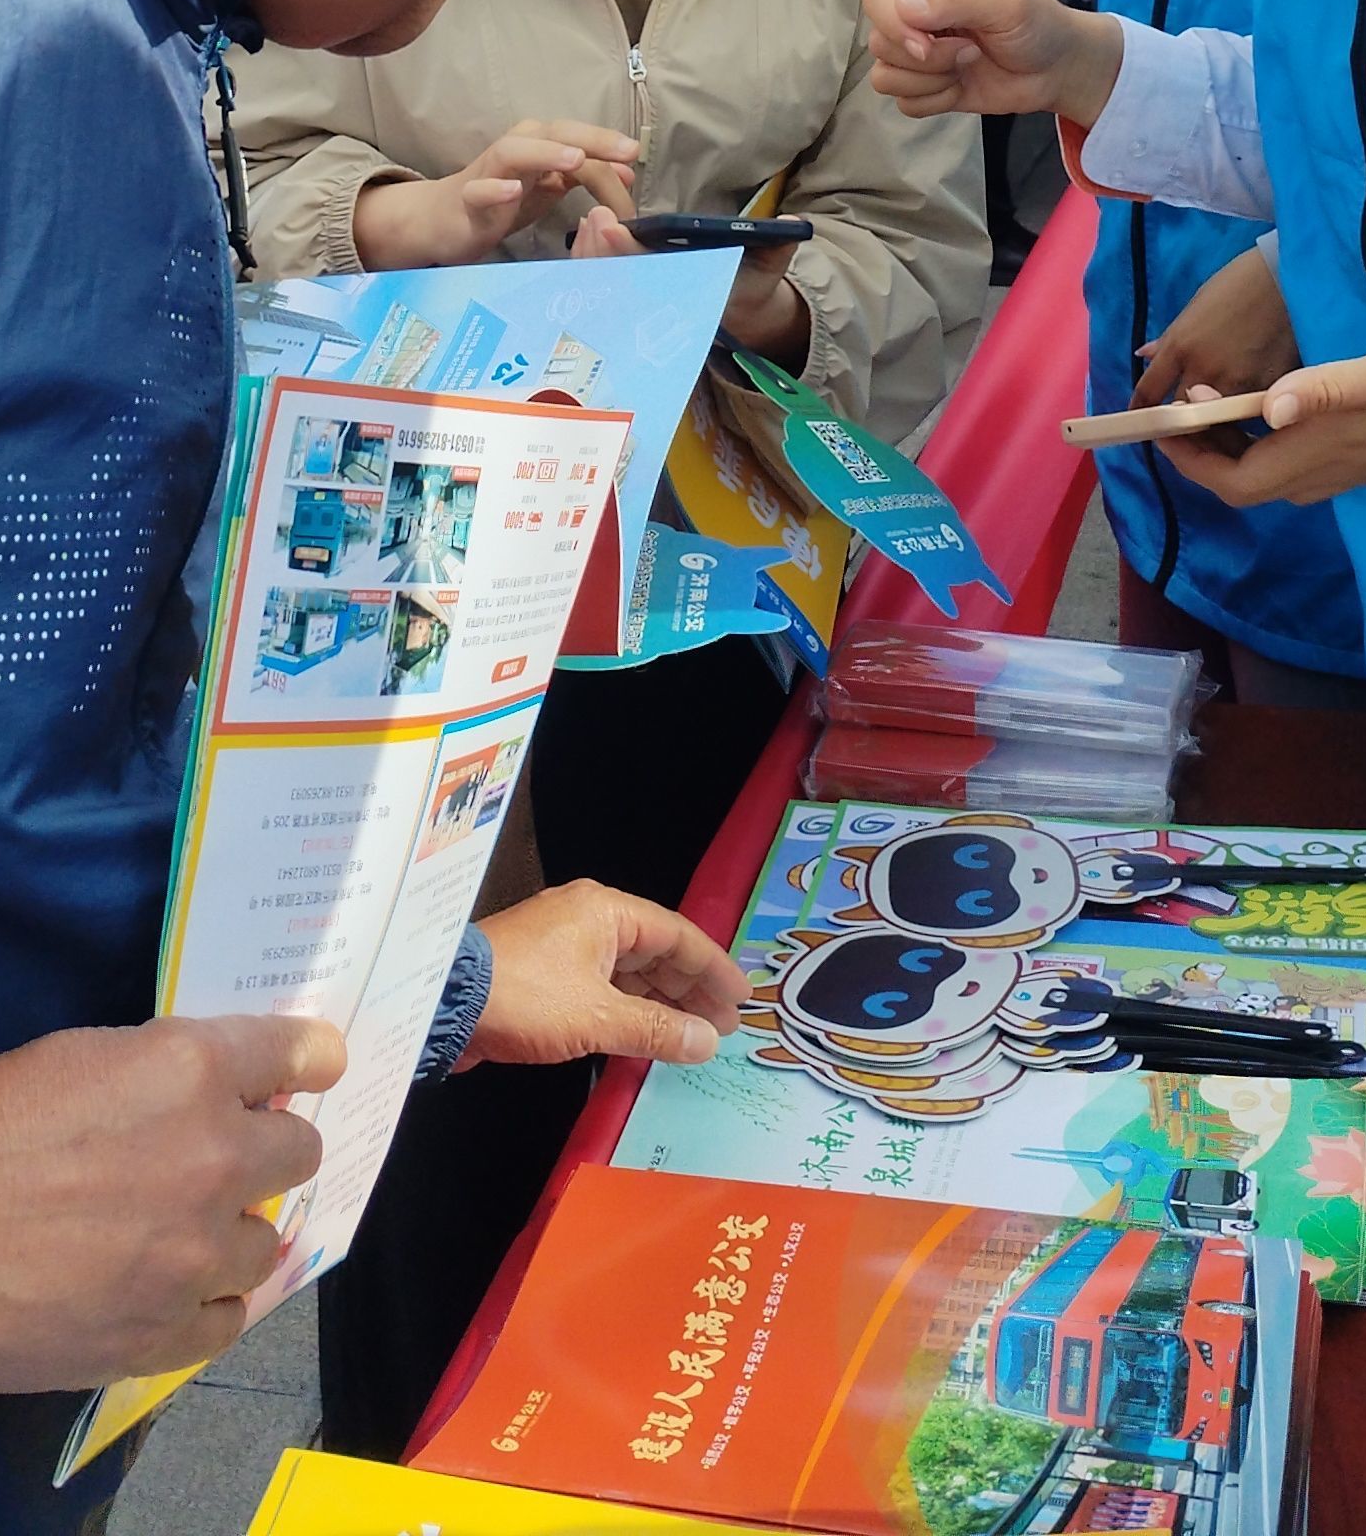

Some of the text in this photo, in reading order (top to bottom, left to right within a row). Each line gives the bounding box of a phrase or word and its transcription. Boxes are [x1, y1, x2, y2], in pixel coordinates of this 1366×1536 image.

[398, 429, 474, 453] 0531-81256616
[684, 573, 706, 632] 济南公交
[627, 1213, 770, 1465] 建设人民满意公交
[745, 1328, 772, 1375] 平安公交
[764, 1272, 790, 1317] 生态公交
[782, 1221, 807, 1262] 人文公交
